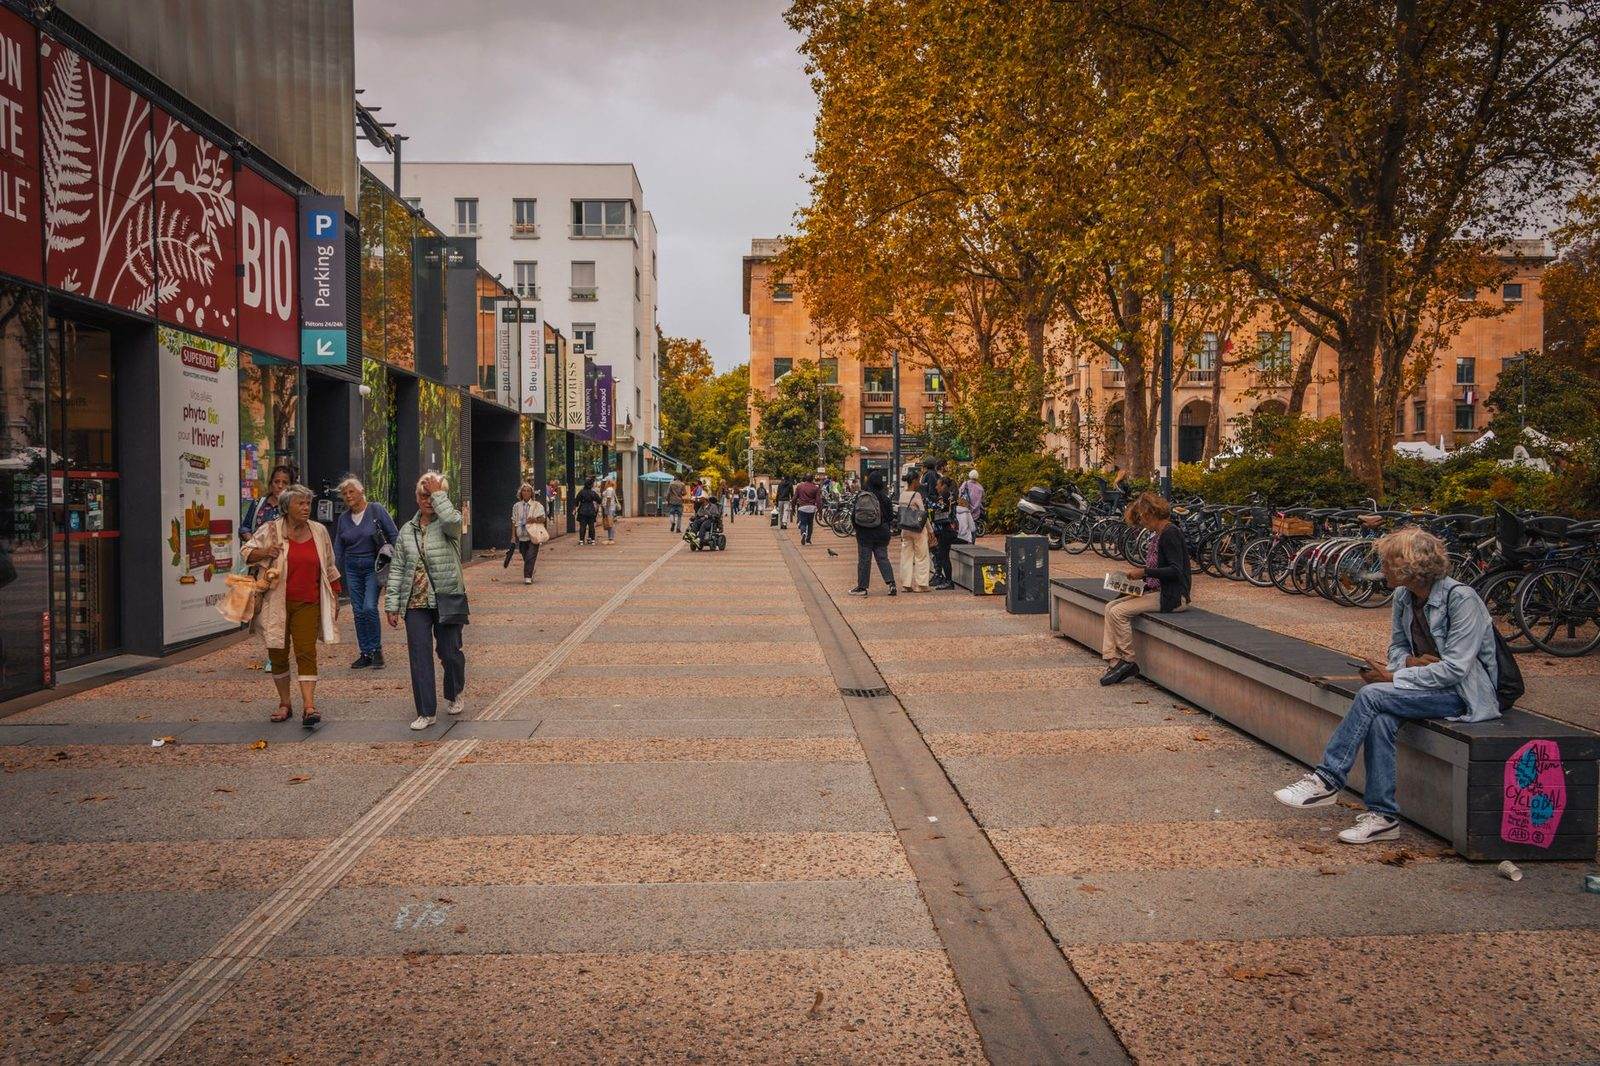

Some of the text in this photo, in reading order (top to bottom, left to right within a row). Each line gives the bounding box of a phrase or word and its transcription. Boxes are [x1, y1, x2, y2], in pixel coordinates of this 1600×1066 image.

[316, 215, 332, 235] P
[242, 204, 292, 321] BIO
[314, 245, 334, 307] Parking
[184, 349, 218, 368] SUPERDIET
[528, 329, 537, 369] Libellule
[529, 371, 537, 392] Bleu
[568, 362, 577, 408] MORISS
[183, 403, 207, 423] phyto
[598, 388, 609, 432] Marionnaud
[177, 431, 190, 441] pour
